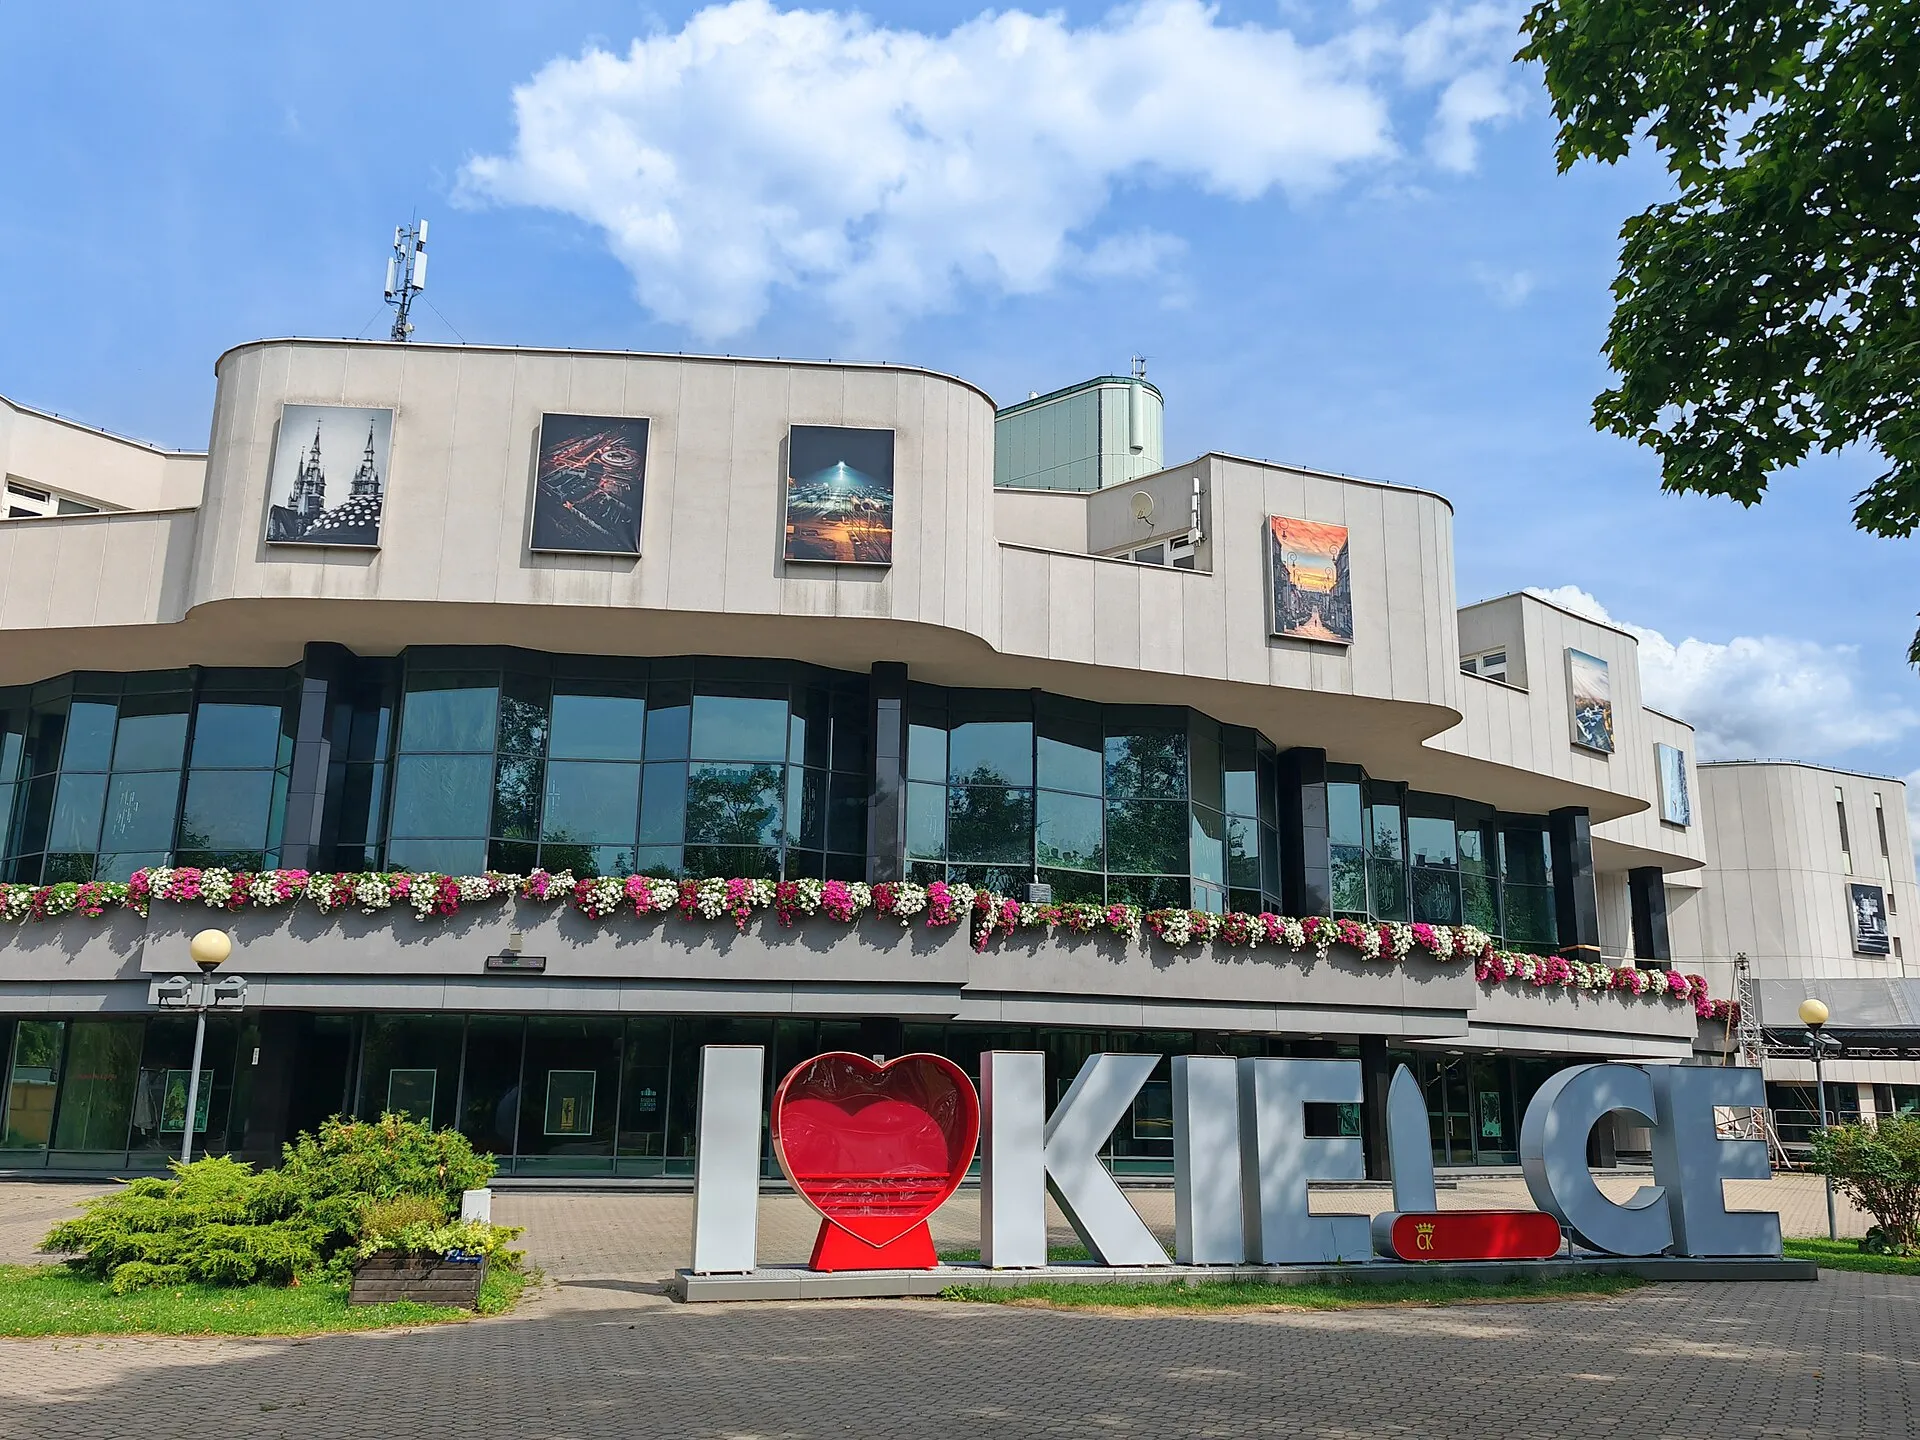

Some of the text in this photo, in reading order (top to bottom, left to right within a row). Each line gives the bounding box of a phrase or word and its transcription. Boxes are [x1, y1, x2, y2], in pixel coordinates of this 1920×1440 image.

[693, 1045, 1782, 1274] I KIELCE
[1416, 1233, 1434, 1250] CK
